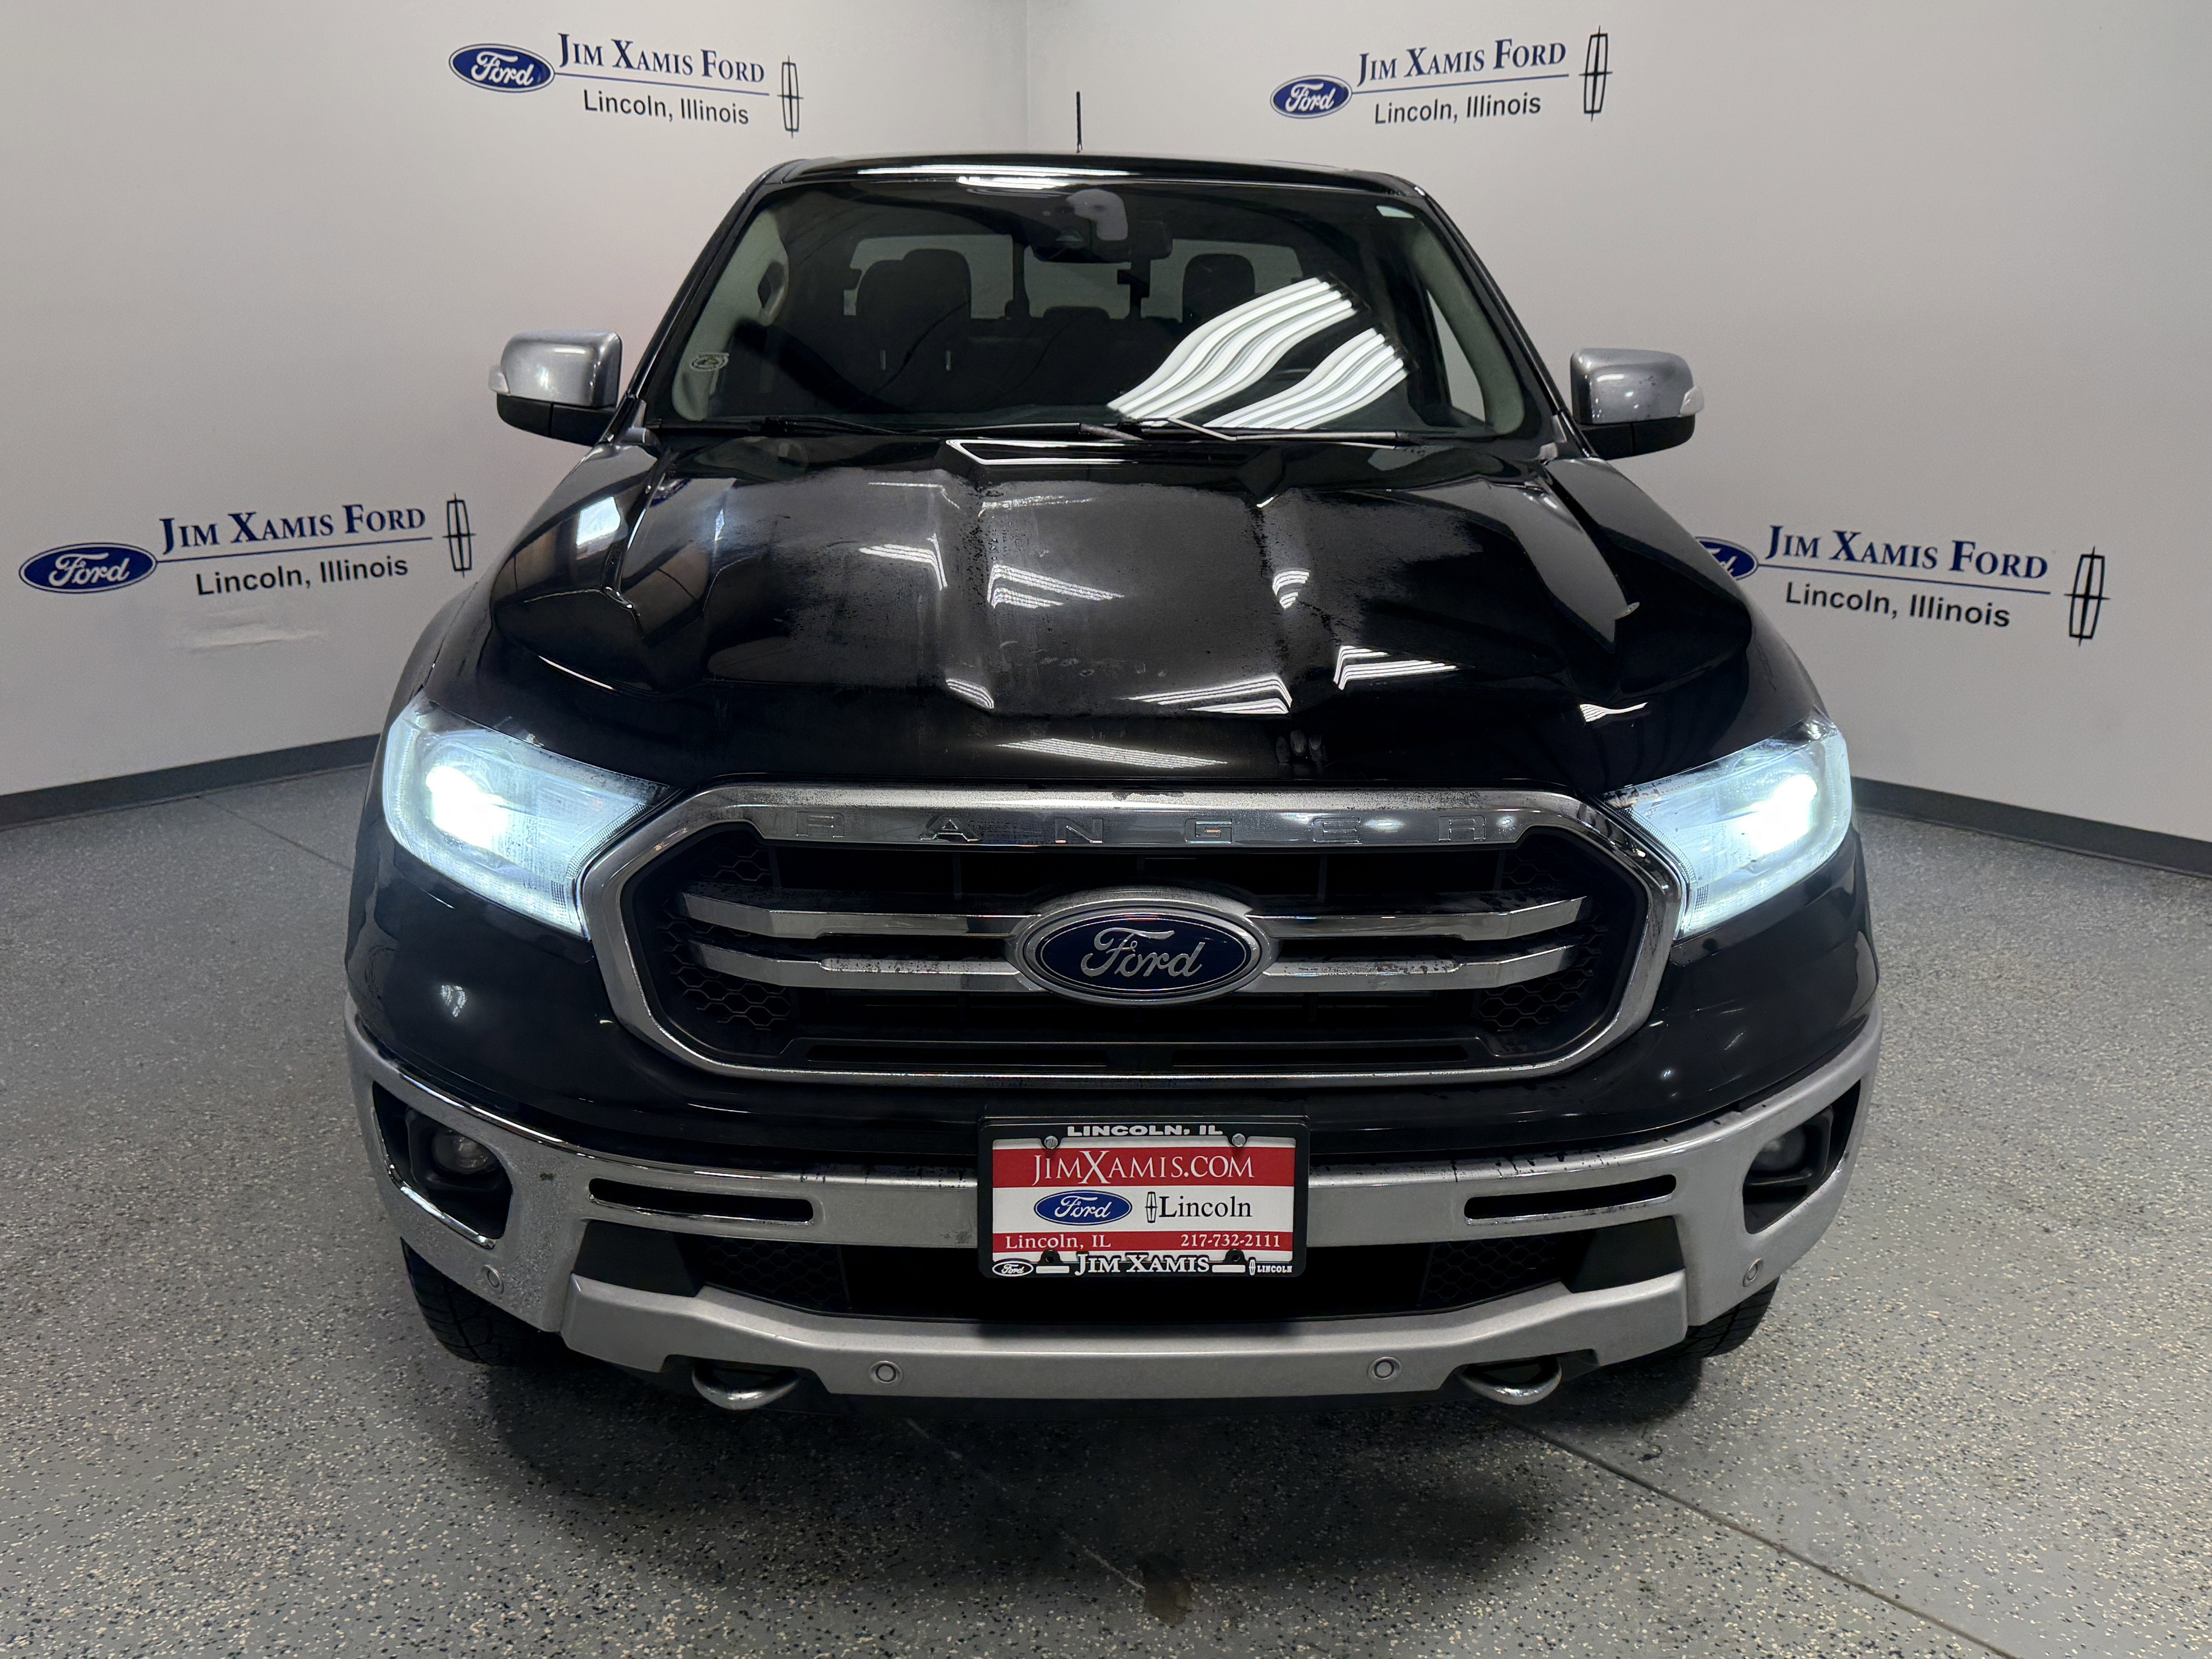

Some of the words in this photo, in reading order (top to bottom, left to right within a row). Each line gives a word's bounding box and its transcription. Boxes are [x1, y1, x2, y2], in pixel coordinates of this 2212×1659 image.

[470, 51, 534, 87] Ford
[558, 33, 603, 68] JIM
[611, 39, 693, 76] XAMIS
[700, 49, 765, 82] FORD
[1357, 53, 1397, 86] JIM
[1403, 47, 1485, 77] XAMIS
[1493, 38, 1566, 69] FORD
[584, 89, 673, 122] Lincoln,
[681, 98, 749, 125] Illinois
[1285, 82, 1335, 112] Ford
[1375, 98, 1458, 125] Lincoln,
[1467, 92, 1541, 119] Illinois
[159, 517, 220, 555] JIM
[229, 511, 335, 544] XAMIS
[342, 504, 426, 534] FORD
[1765, 525, 1820, 560] JIM
[1829, 530, 1938, 570] XAMIS
[1948, 540, 2048, 579] FORD
[48, 552, 131, 586] Ford
[196, 565, 311, 595] Lincoln,
[320, 556, 408, 582] Illinois
[1786, 581, 1898, 618] Lincoln,
[1910, 594, 2010, 627] Illinois
[796, 811, 1486, 844] RANGER
[1080, 927, 1206, 978] Ford
[1067, 1125, 1190, 1137] LINCOLN,
[1199, 1125, 1223, 1135] IL
[1053, 1197, 1112, 1218] Ford
[1159, 1196, 1252, 1218] Lincoln
[1006, 1234, 1084, 1250] Lincoln,
[1091, 1235, 1111, 1248] IL
[1181, 1234, 1280, 1247] 217-732-2111
[1001, 1264, 1025, 1274] Ford
[1074, 1253, 1120, 1276] JIM
[1126, 1255, 1209, 1273] XAMIS
[1257, 1265, 1293, 1273] LINCOLN
